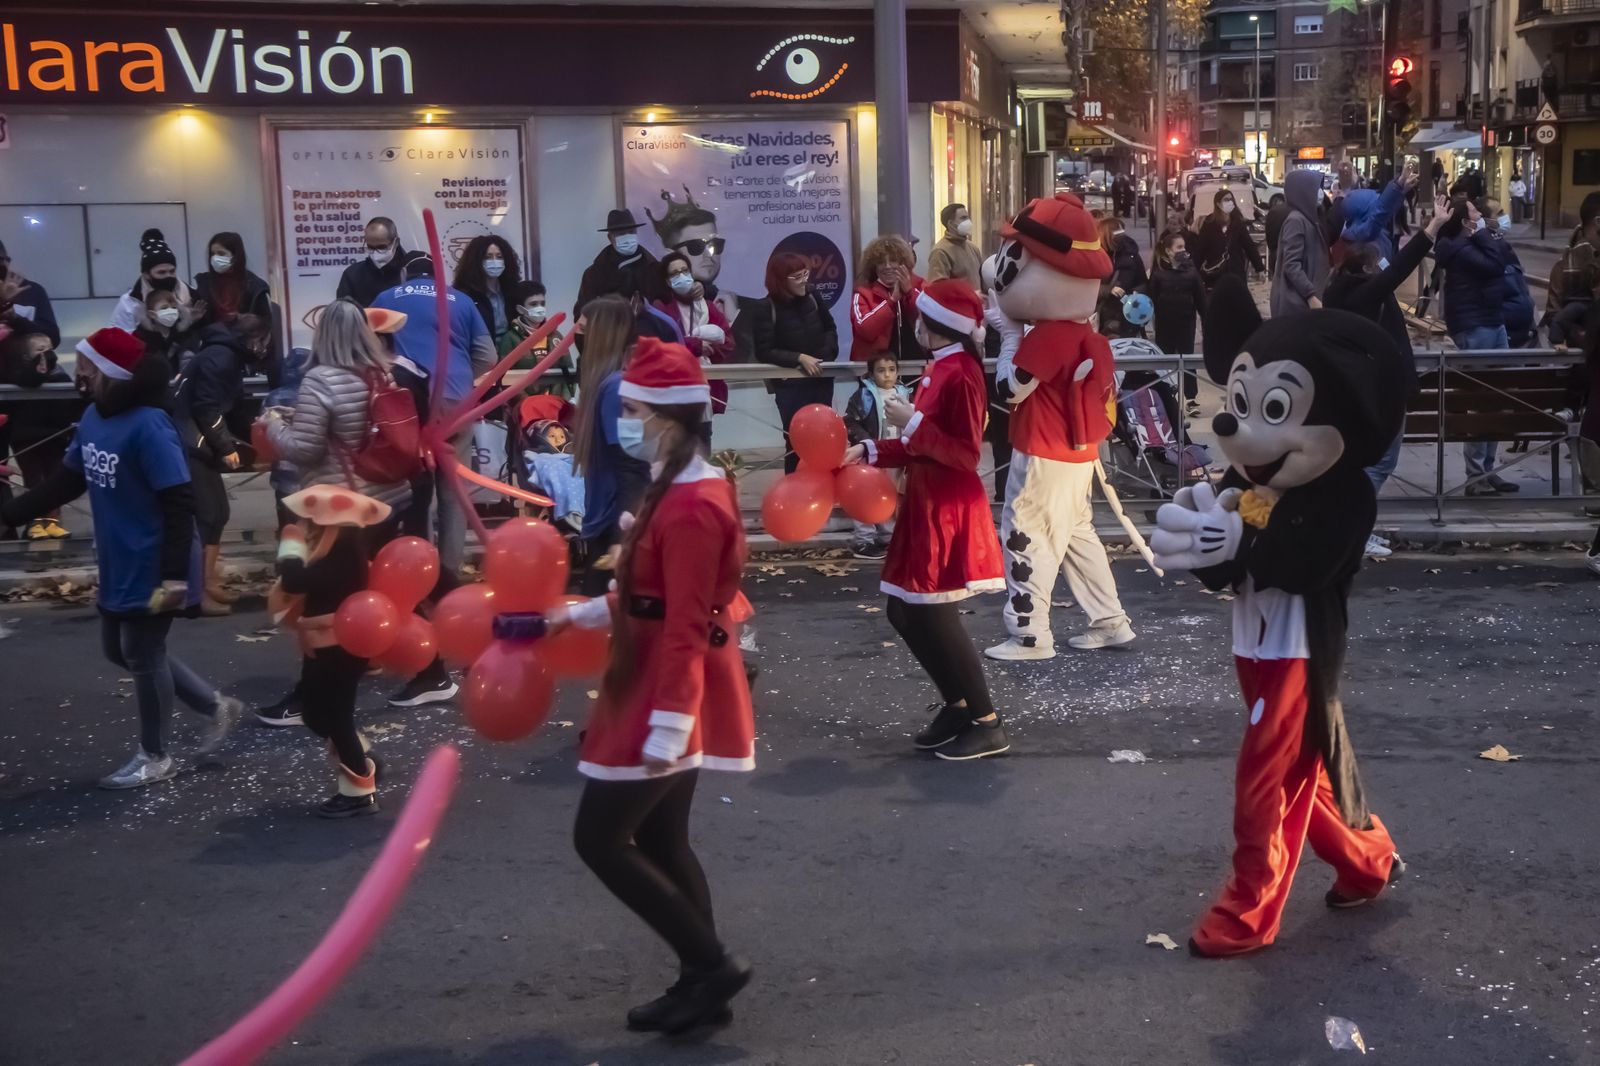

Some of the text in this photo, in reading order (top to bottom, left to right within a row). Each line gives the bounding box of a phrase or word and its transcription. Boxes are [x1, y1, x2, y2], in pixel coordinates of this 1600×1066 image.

[2, 23, 414, 94] laraVisión
[748, 131, 835, 147] Navidades,
[1540, 130, 1553, 138] 30
[292, 148, 510, 161] OPTICAS ClaraVisión
[731, 150, 839, 169] ¡tú eres el rey!
[442, 177, 507, 187] Revisiones
[707, 176, 722, 187] En
[724, 176, 733, 186] la
[735, 175, 764, 186] Corte
[767, 174, 780, 184] de
[293, 189, 381, 199] Para nosotros
[434, 187, 507, 199] con la mejor
[724, 186, 840, 200] tenemos a los mejores
[294, 200, 360, 213] lo primero
[748, 200, 840, 213] profesionales para
[295, 211, 361, 222] es la salud
[762, 214, 795, 225] cuidar
[797, 214, 809, 223] tu
[295, 224, 311, 233] de
[314, 223, 335, 232] tus
[296, 235, 342, 246] porque
[297, 245, 365, 255] tu ventana
[297, 257, 309, 267] al
